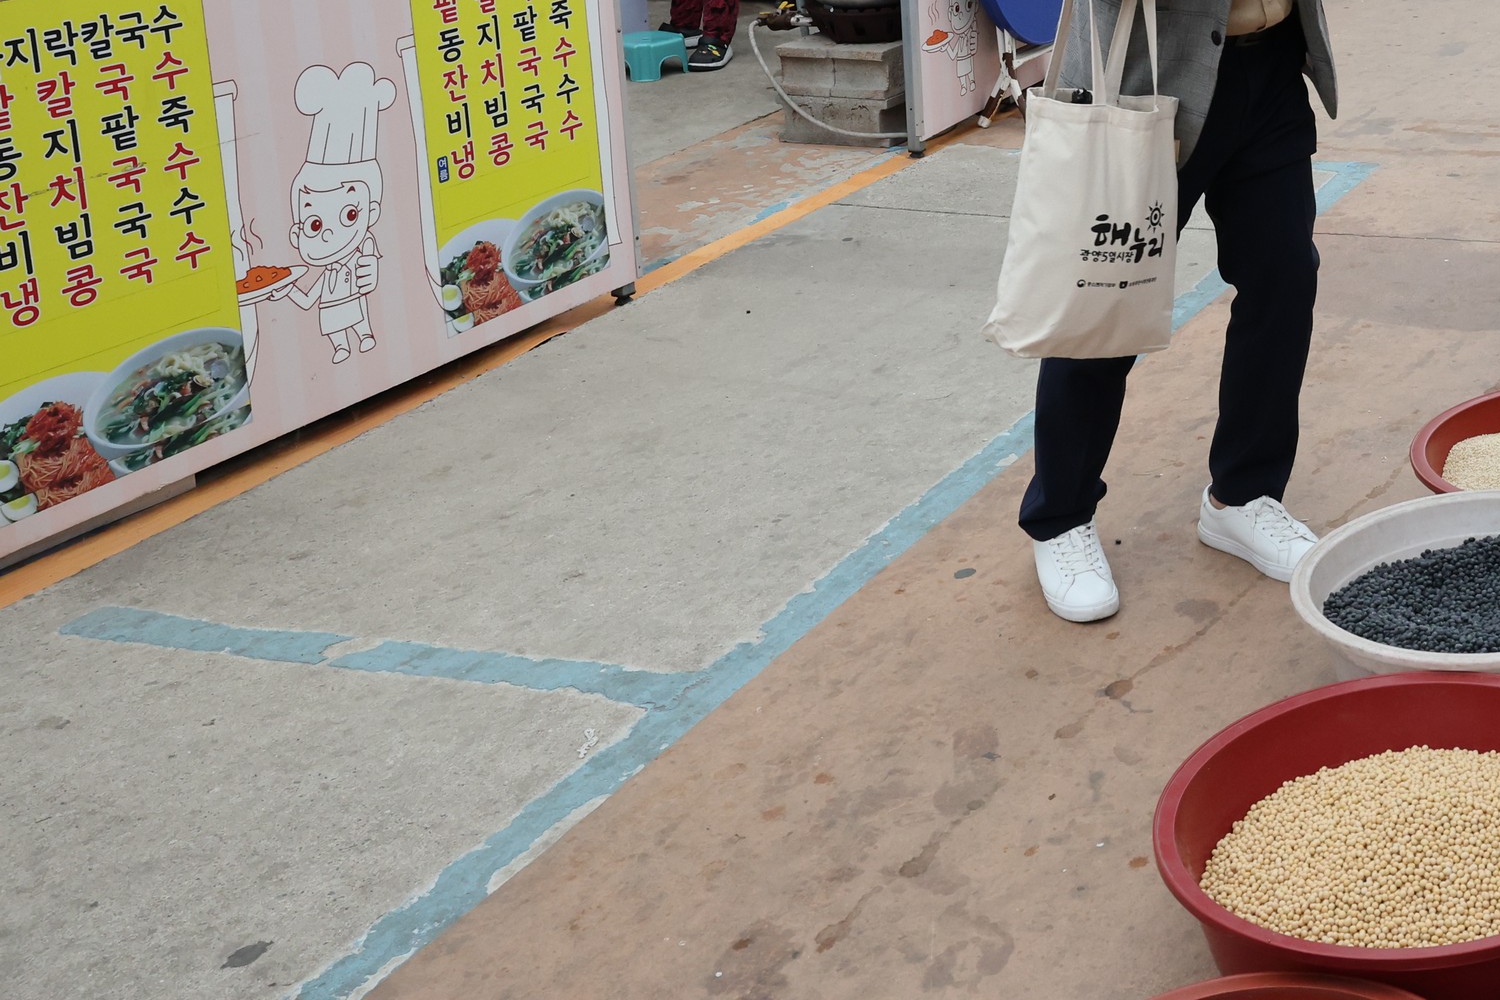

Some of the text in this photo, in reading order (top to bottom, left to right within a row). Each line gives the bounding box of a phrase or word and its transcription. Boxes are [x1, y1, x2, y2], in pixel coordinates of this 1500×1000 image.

[0, 5, 183, 73] 지락칼국수
[1079, 249, 1134, 263] 광양5일시장
[1091, 214, 1165, 263] 해누리
